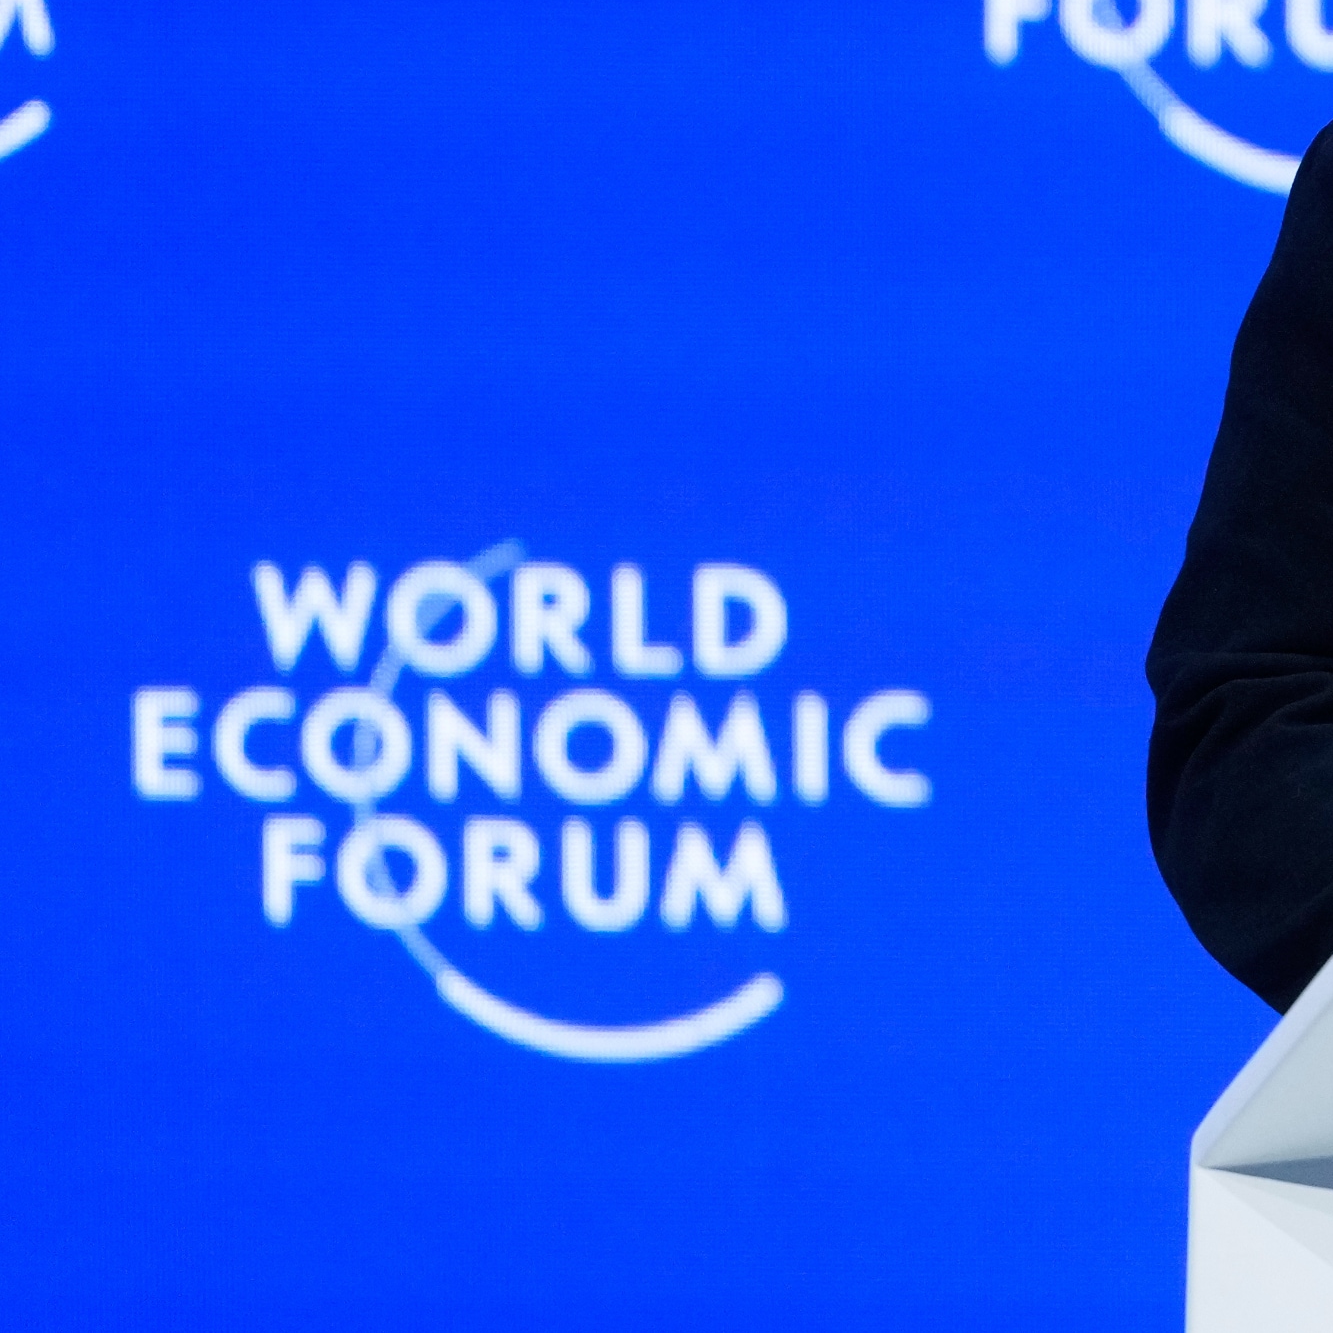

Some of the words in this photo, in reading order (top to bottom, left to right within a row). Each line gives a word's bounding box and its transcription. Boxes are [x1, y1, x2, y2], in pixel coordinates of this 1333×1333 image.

[253, 560, 788, 678] WORLD
[132, 685, 933, 806] ECONOMIC
[261, 814, 788, 931] FORUM
